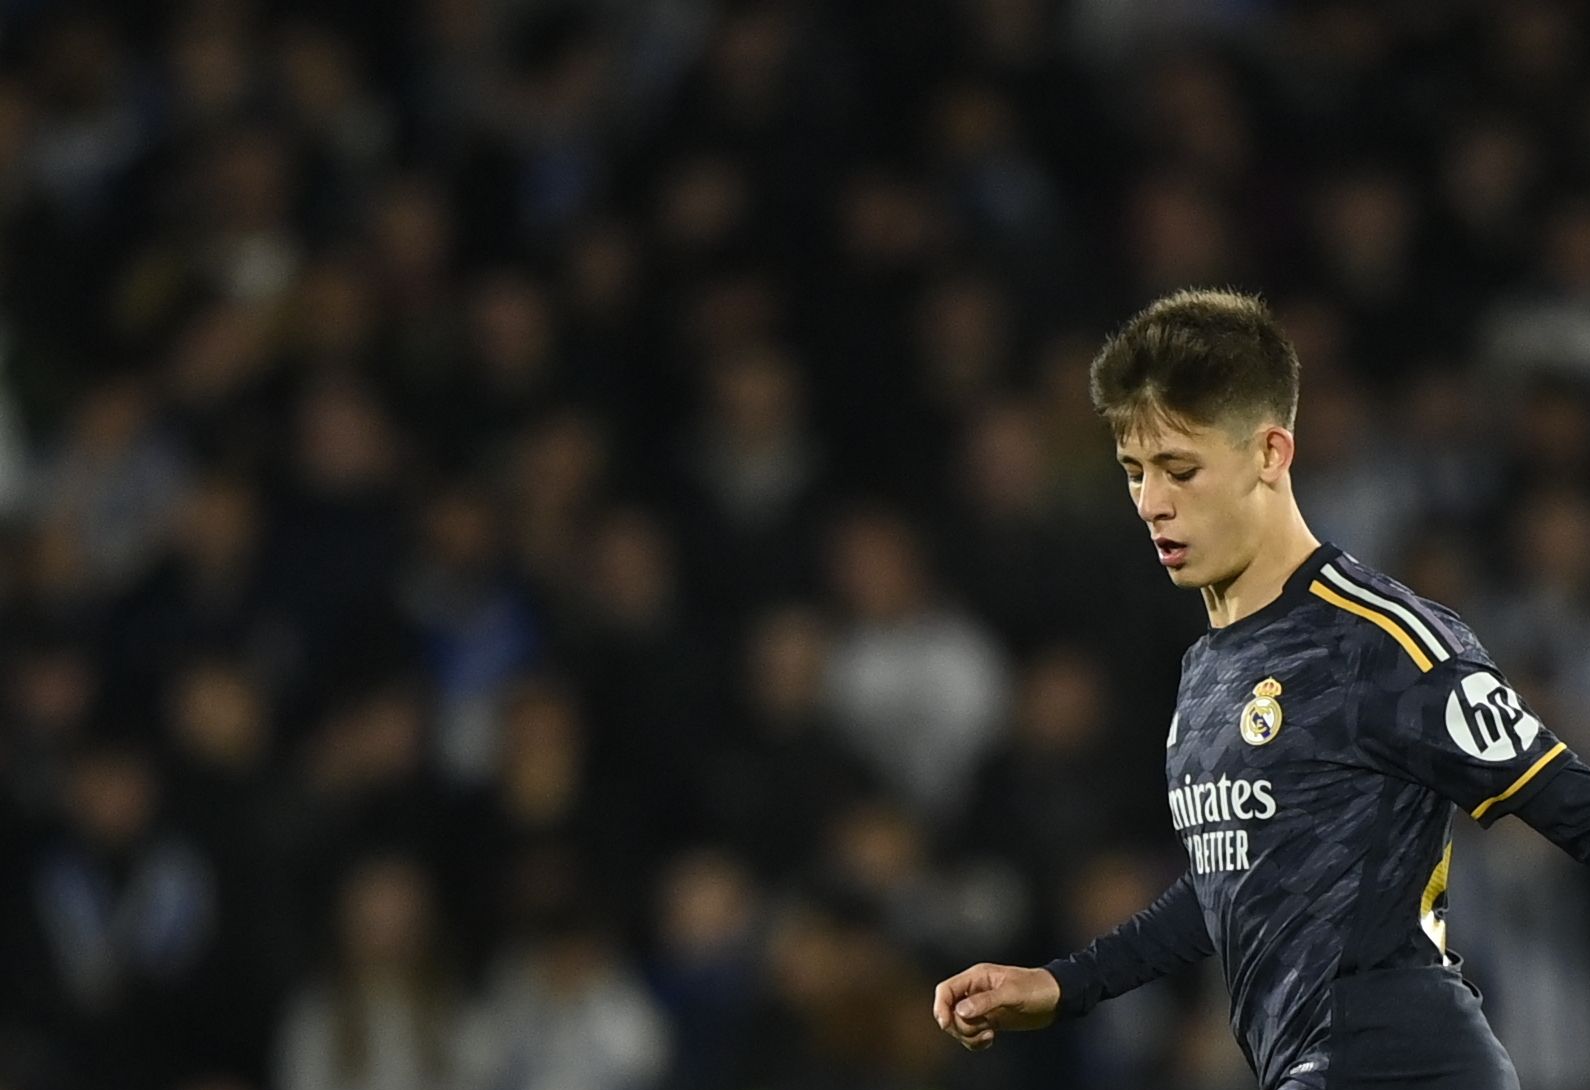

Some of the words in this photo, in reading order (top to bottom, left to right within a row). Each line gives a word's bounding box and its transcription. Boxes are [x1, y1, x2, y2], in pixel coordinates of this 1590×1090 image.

[1449, 676, 1531, 758] hp
[1168, 772, 1277, 831] mirates
[1192, 829, 1250, 875] BETTER
